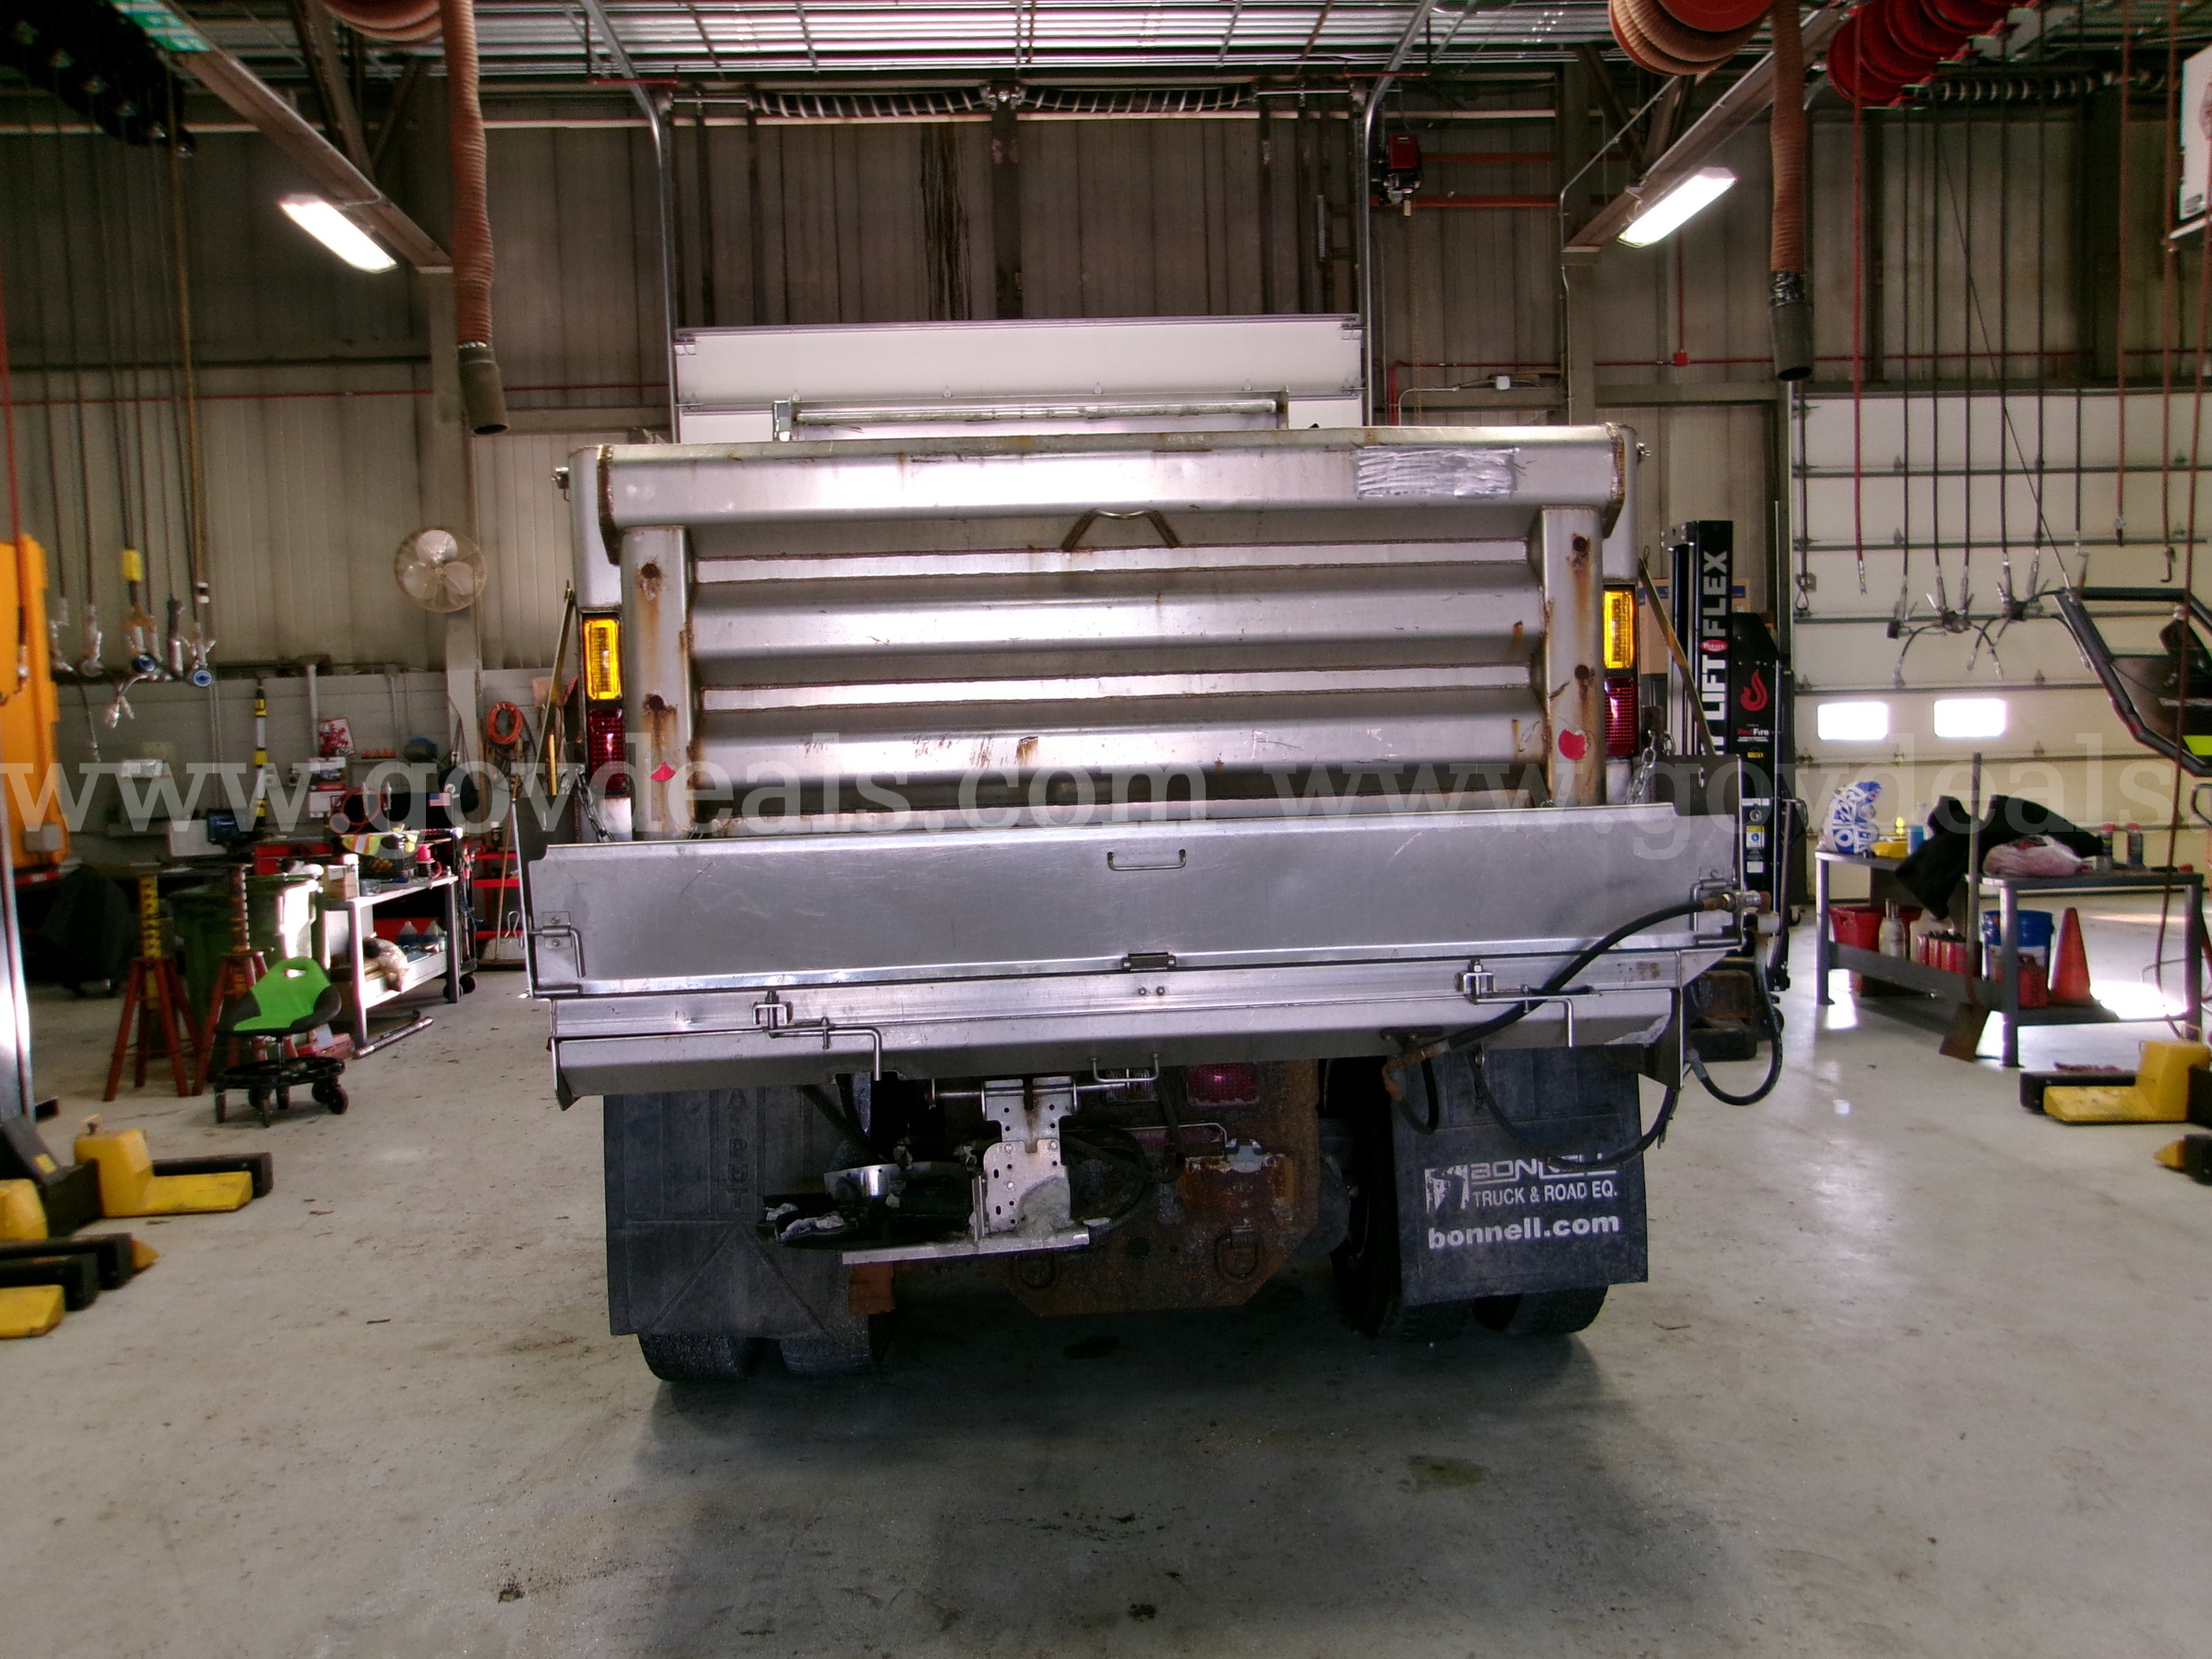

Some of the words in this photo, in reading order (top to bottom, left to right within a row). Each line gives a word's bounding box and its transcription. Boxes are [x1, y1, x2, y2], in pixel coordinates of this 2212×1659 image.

[1702, 551, 1728, 637] FLEX
[1701, 654, 1727, 721] LIFT
[1473, 1187, 1526, 1208] TRUCK
[1530, 1185, 1541, 1203] &
[1544, 1181, 1588, 1203] ROAD
[1591, 1179, 1618, 1199] EQ.
[1428, 1215, 1620, 1250] bonnell.com
